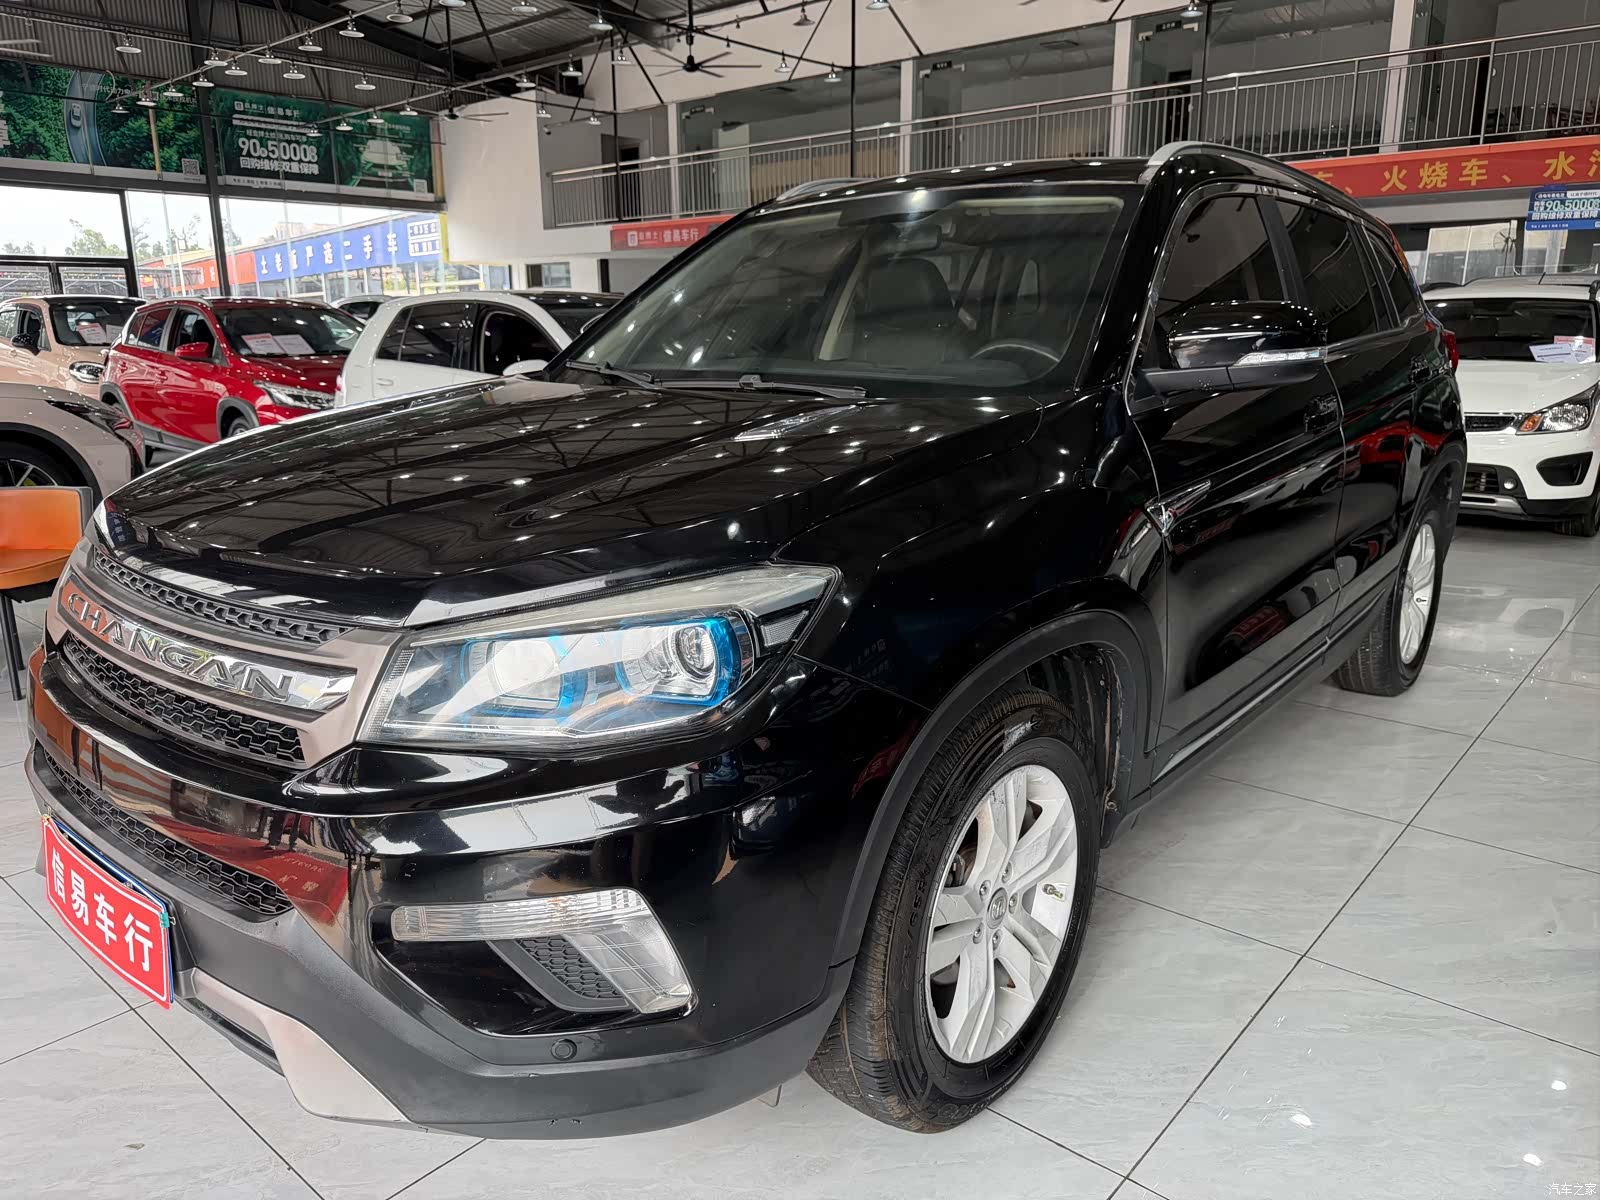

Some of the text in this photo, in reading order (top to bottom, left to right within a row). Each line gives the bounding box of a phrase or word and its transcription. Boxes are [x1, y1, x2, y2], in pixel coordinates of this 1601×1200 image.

[240, 156, 320, 175] 回购维修双重保障
[1313, 148, 1600, 194] 、火烧车、水
[663, 228, 699, 243] 信易车行
[68, 593, 294, 701] CHANGAN
[51, 847, 154, 972] 信易车行
